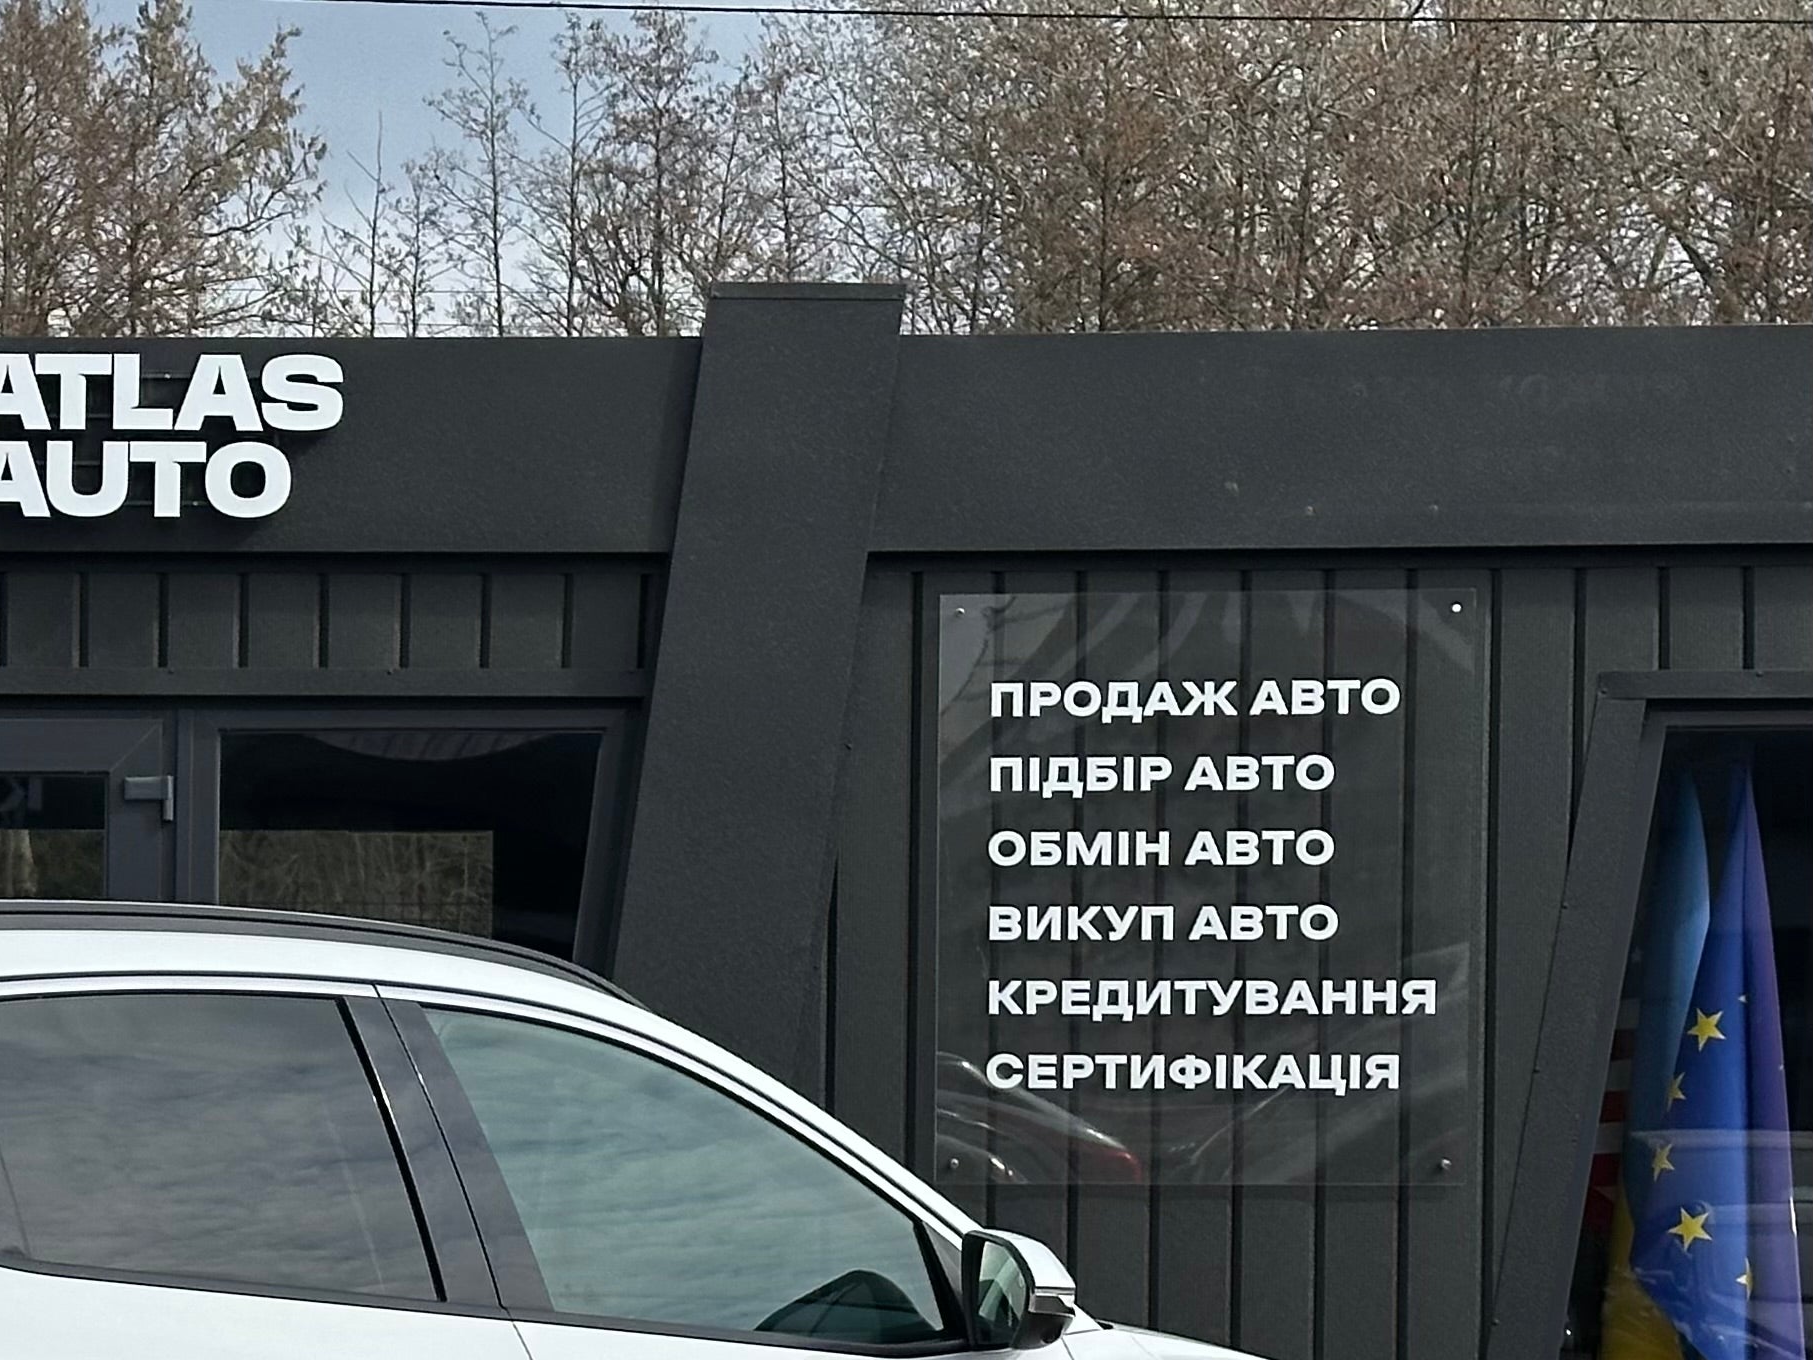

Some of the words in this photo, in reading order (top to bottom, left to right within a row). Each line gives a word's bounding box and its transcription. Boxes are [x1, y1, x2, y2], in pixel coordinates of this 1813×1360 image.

[990, 680, 1238, 723] ПРОДАЖ
[1249, 678, 1401, 716] АВТО
[990, 756, 1173, 798] ПІДБІР
[1184, 754, 1335, 791] АВТО
[988, 830, 1170, 867] ОБМІН
[1184, 829, 1335, 866] АВТО
[989, 905, 1174, 941] ВИКУП
[1188, 904, 1339, 941] АВТО
[988, 979, 1437, 1021] КРЕДИТУВАННЯ
[986, 1053, 1400, 1096] СЕРТИФІКАЦІЯ
